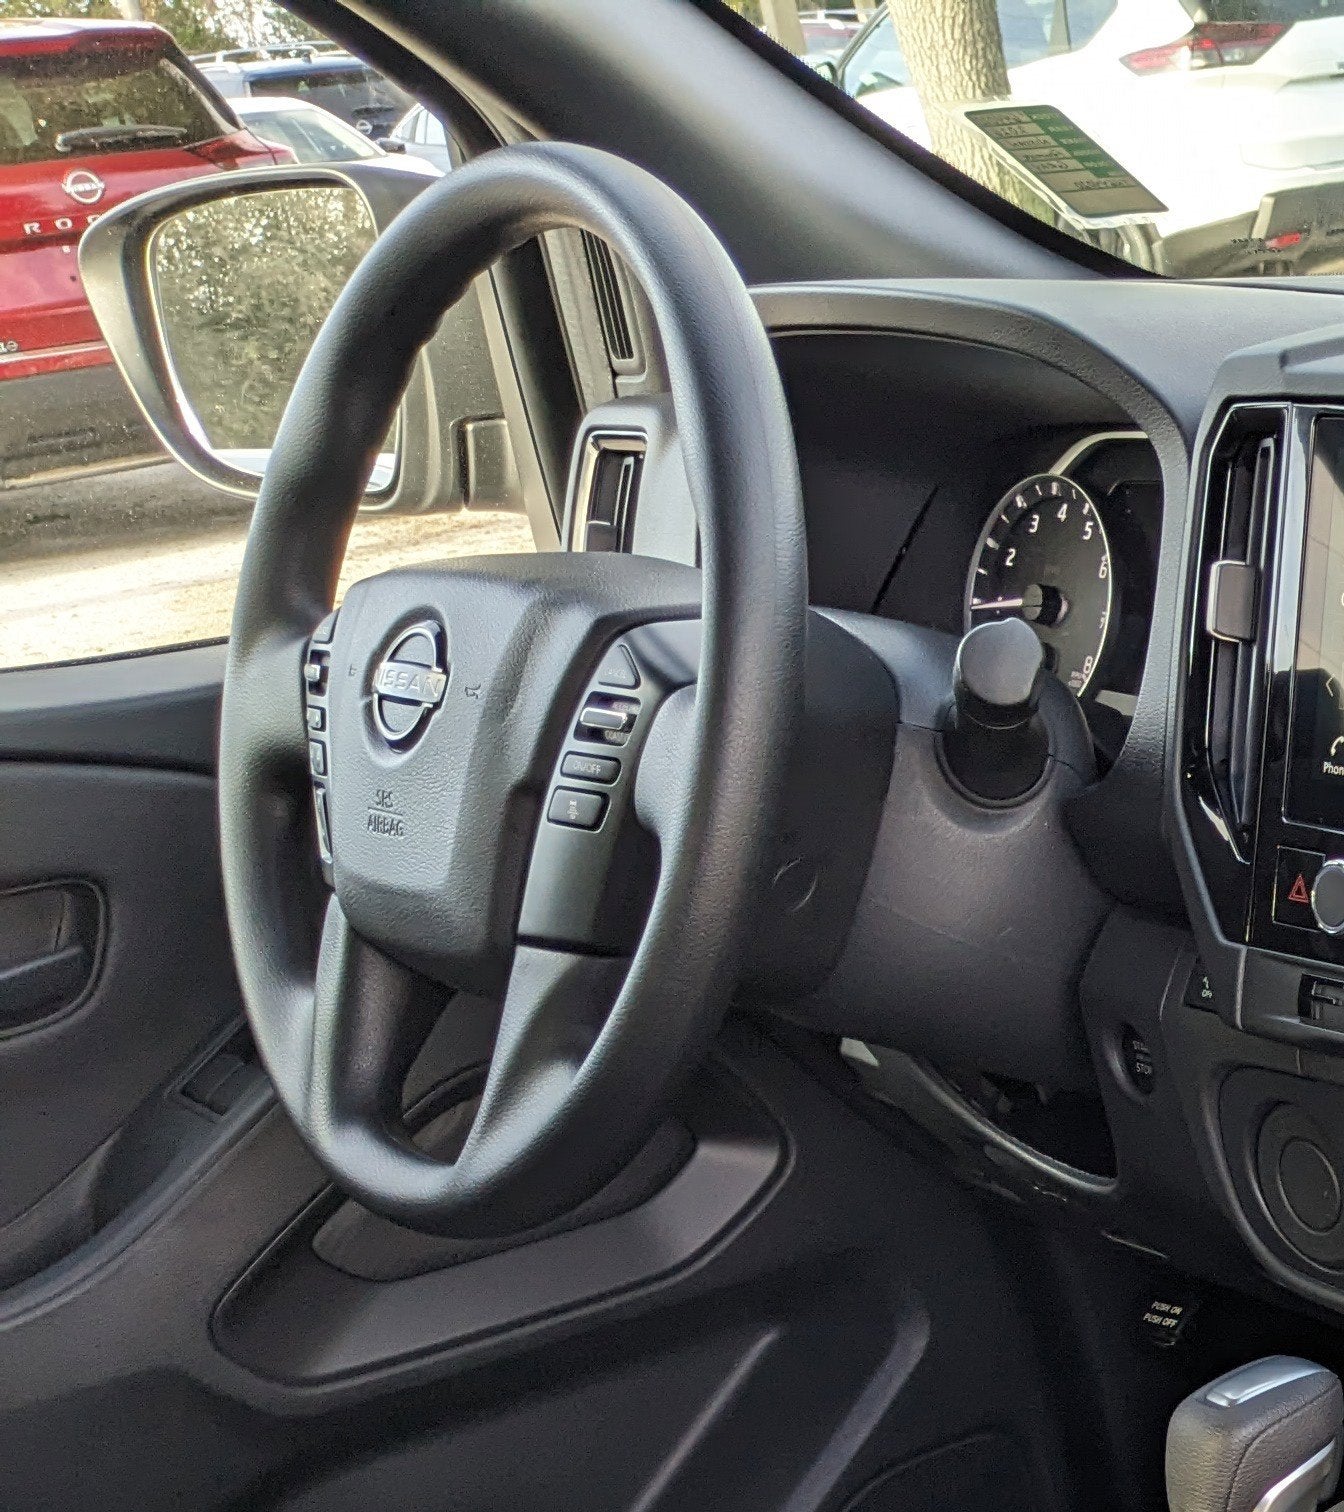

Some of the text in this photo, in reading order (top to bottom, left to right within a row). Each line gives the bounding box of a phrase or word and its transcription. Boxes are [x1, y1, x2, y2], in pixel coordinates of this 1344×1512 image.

[1057, 504, 1067, 522] 4
[1029, 515, 1039, 533] 3
[1083, 522, 1093, 540] 5
[1005, 549, 1015, 566] 2
[367, 814, 403, 837] AIRBAG
